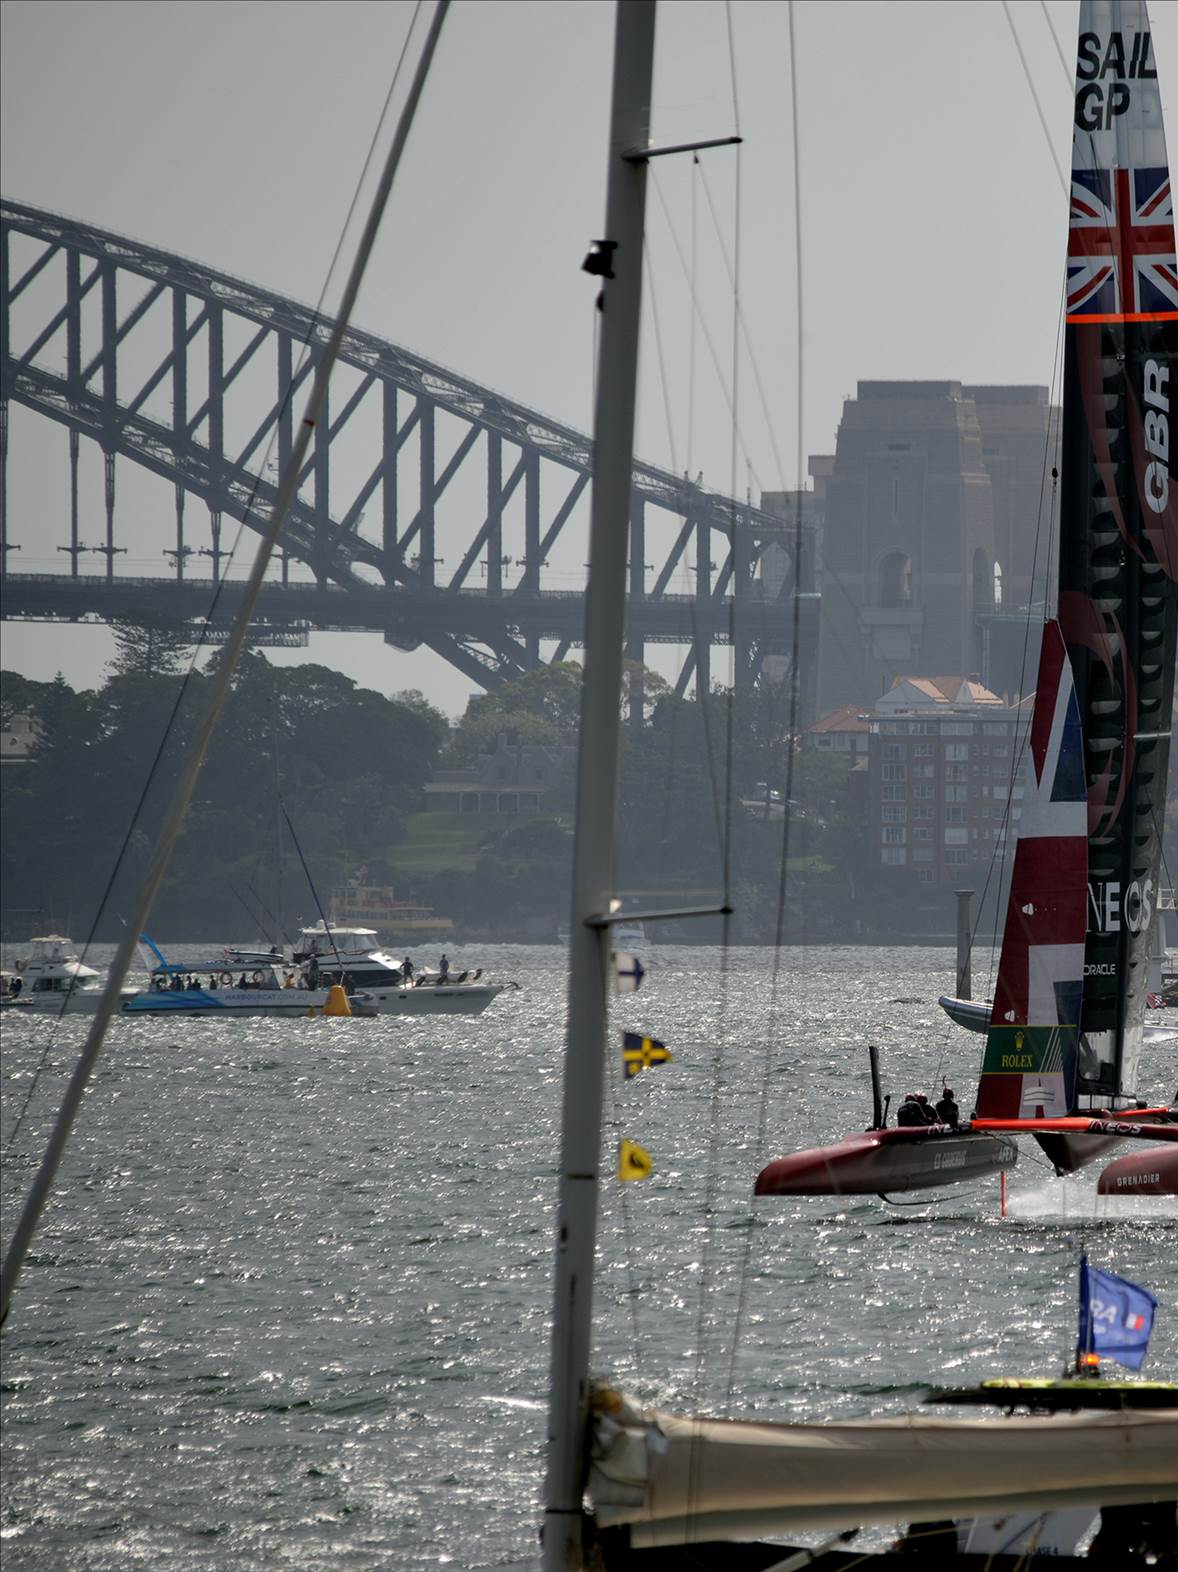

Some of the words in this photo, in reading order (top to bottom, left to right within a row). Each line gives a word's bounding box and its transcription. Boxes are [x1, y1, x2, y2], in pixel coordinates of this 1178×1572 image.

[1076, 32, 1158, 80] SAIL
[1074, 82, 1131, 132] GP
[1143, 359, 1170, 514] GBR
[1086, 879, 1153, 932] NEOS
[1083, 963, 1116, 976] ORACLE
[1001, 1055, 1033, 1067] ROLEX
[1088, 1119, 1142, 1135] INEOS
[1117, 1172, 1161, 1188] GRENADIER
